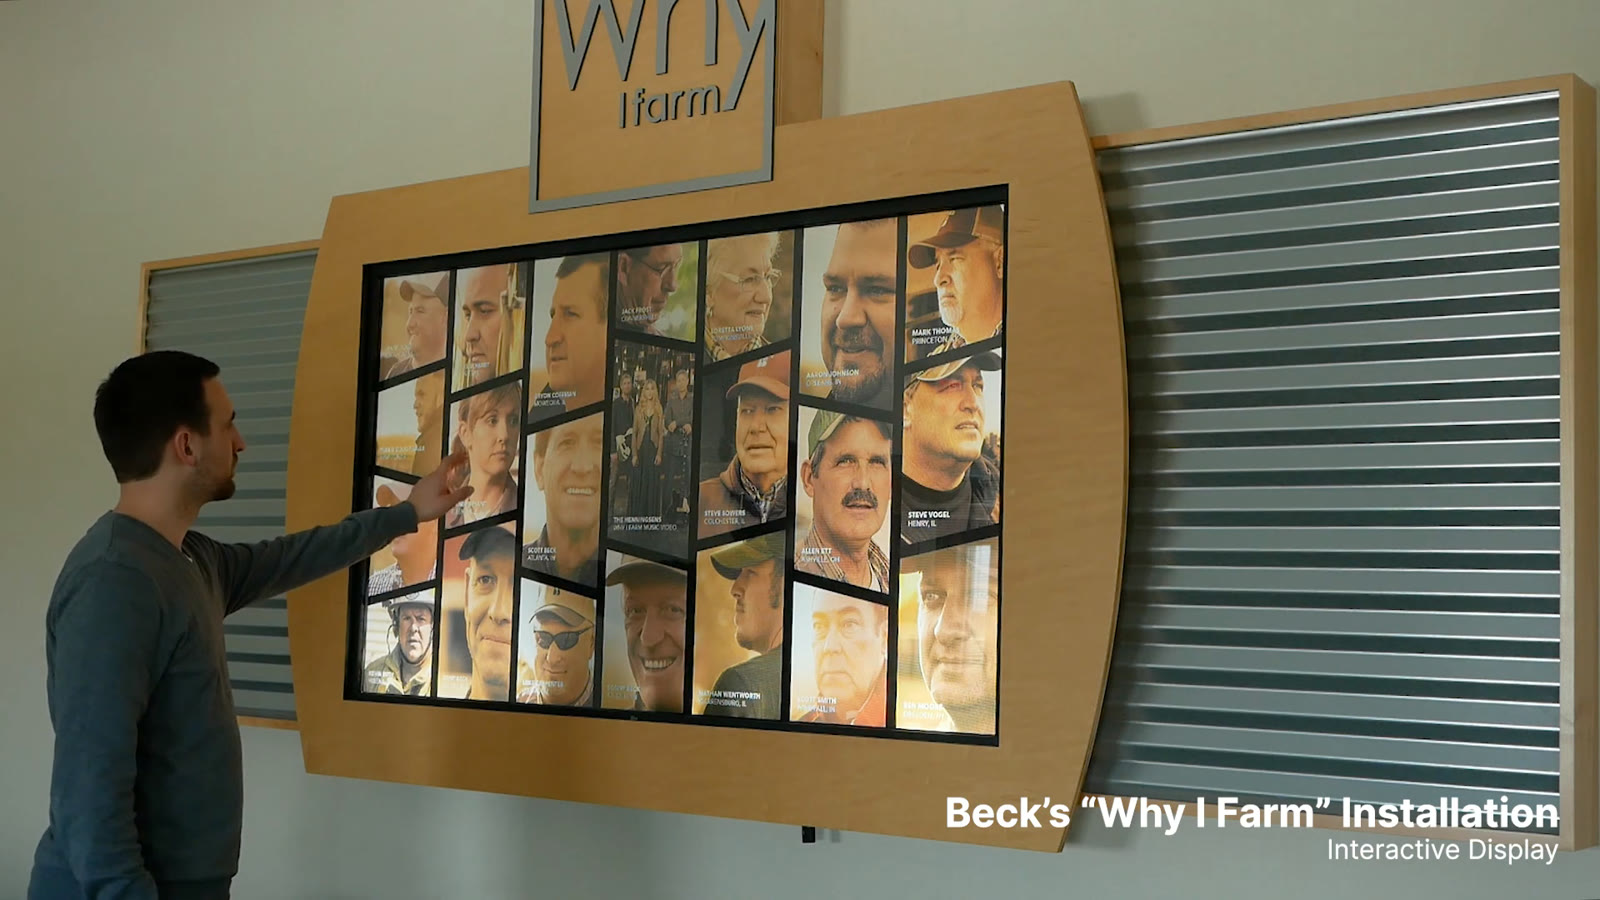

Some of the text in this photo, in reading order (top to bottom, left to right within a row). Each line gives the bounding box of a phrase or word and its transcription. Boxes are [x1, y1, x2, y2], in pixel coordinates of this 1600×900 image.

[619, 86, 721, 128] I farm
[911, 328, 931, 336] MARK
[829, 369, 859, 377] JOHNSON
[908, 511, 927, 519] STEVE
[907, 520, 930, 528] HENRY,
[723, 691, 761, 700] WENTWORTH
